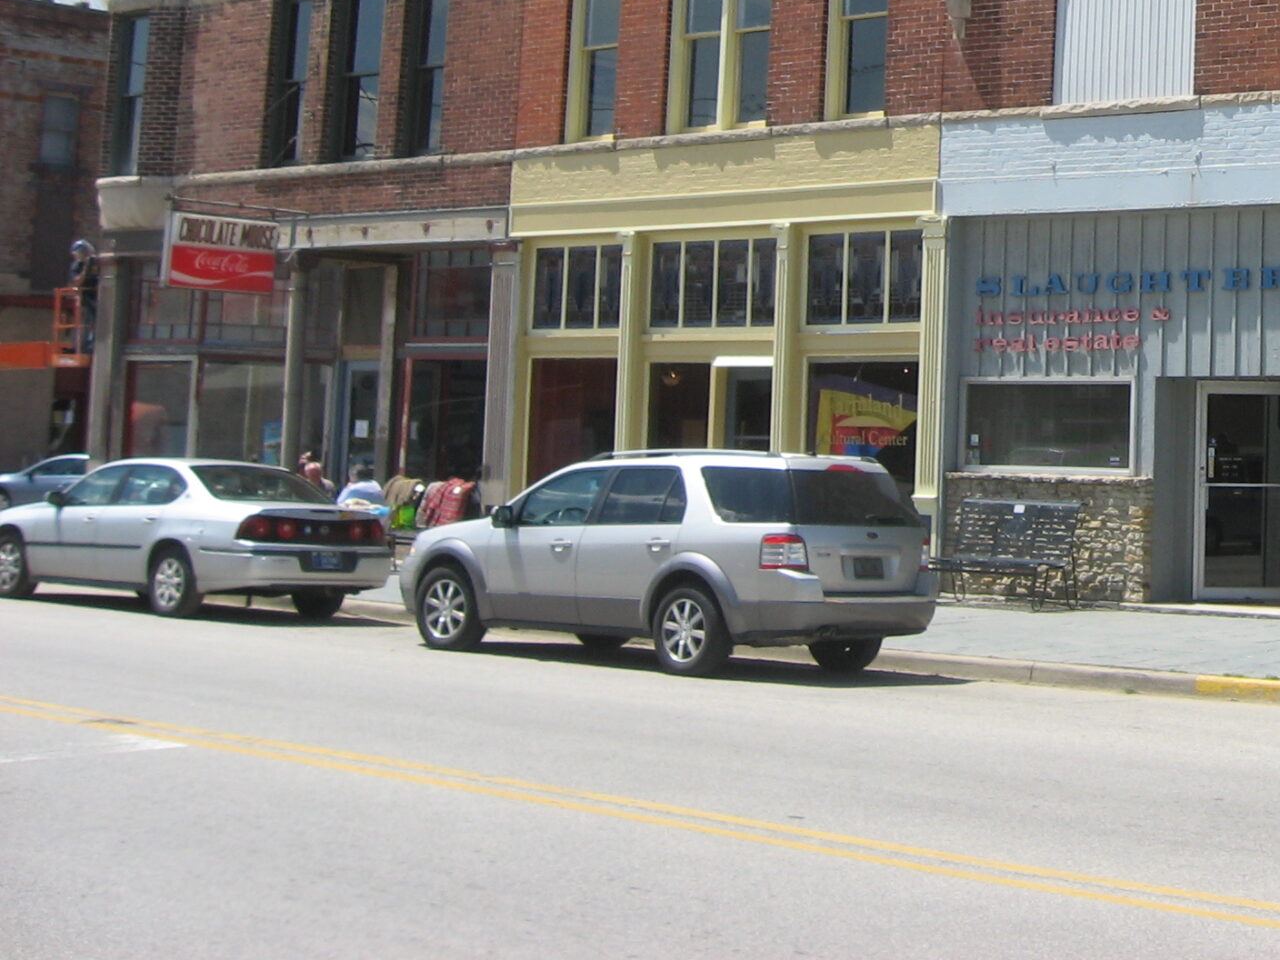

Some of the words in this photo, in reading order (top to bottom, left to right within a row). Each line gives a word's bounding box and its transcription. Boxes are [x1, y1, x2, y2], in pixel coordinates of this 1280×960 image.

[179, 217, 238, 246] CHOCOLATE
[194, 250, 249, 273] Coca-Cola
[974, 304, 1141, 327] insurance
[1149, 305, 1171, 322] &
[973, 332, 1036, 354] real
[1042, 330, 1142, 353] estate
[868, 430, 908, 448] Center
